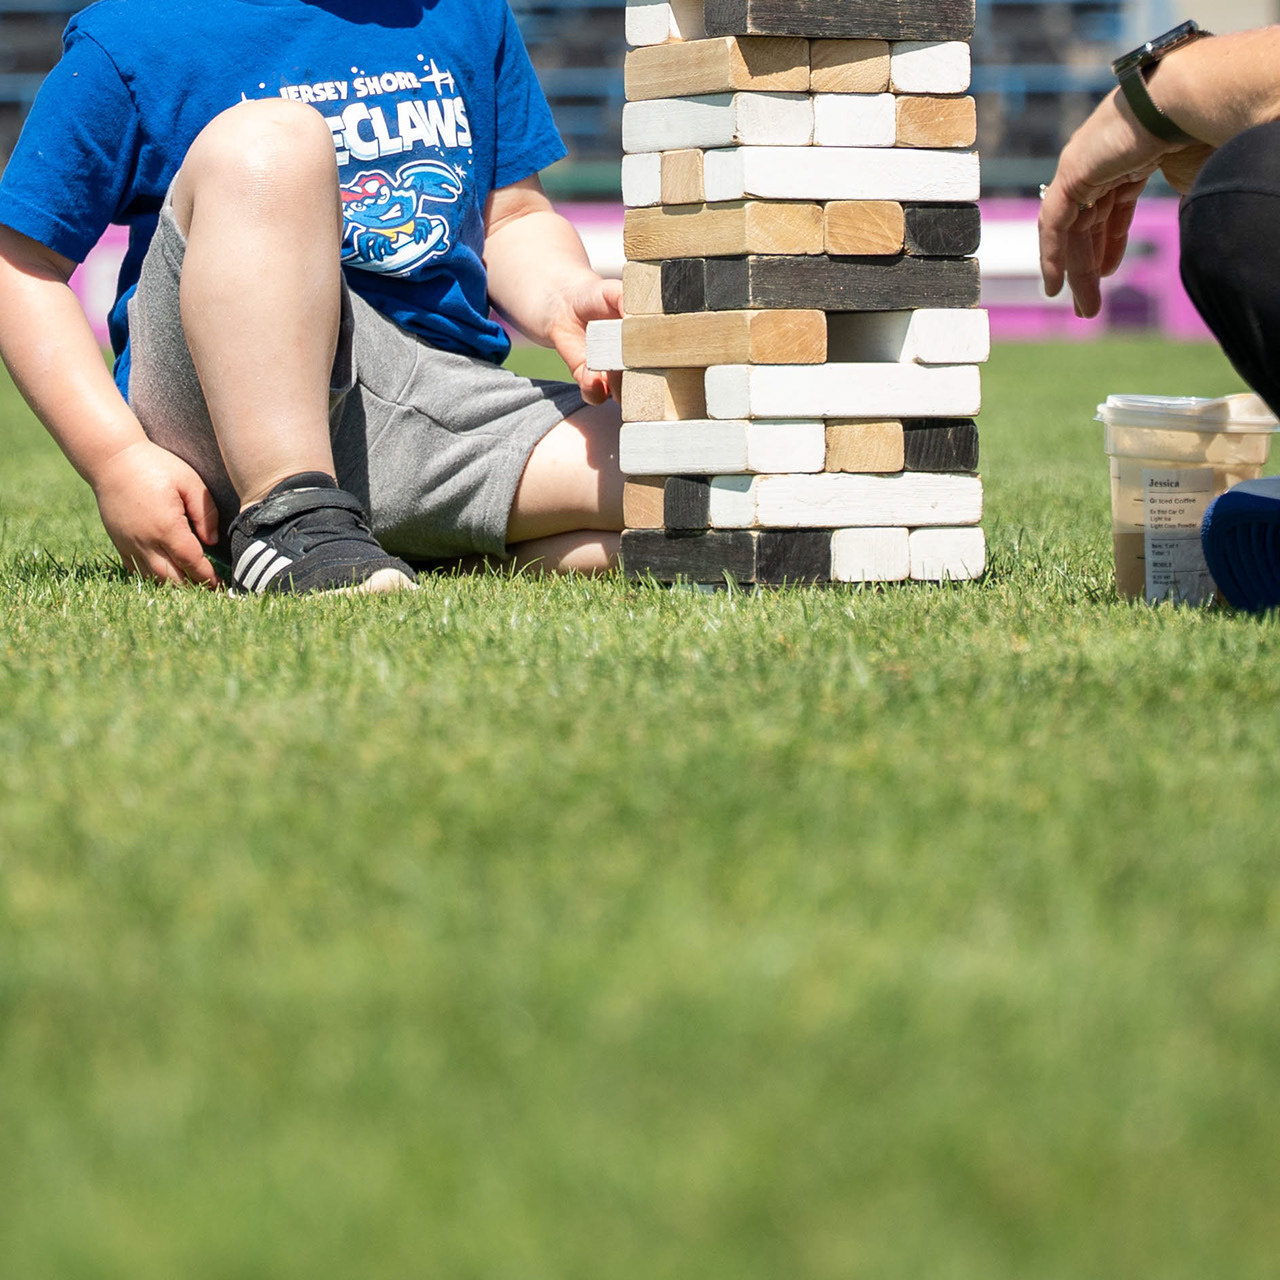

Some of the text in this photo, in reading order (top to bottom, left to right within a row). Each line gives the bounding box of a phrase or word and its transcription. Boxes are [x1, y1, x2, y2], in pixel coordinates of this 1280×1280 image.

[279, 71, 421, 105] JERSEY SHORE
[330, 96, 473, 167] ECLAWS
[1149, 478, 1180, 488] Jessica
